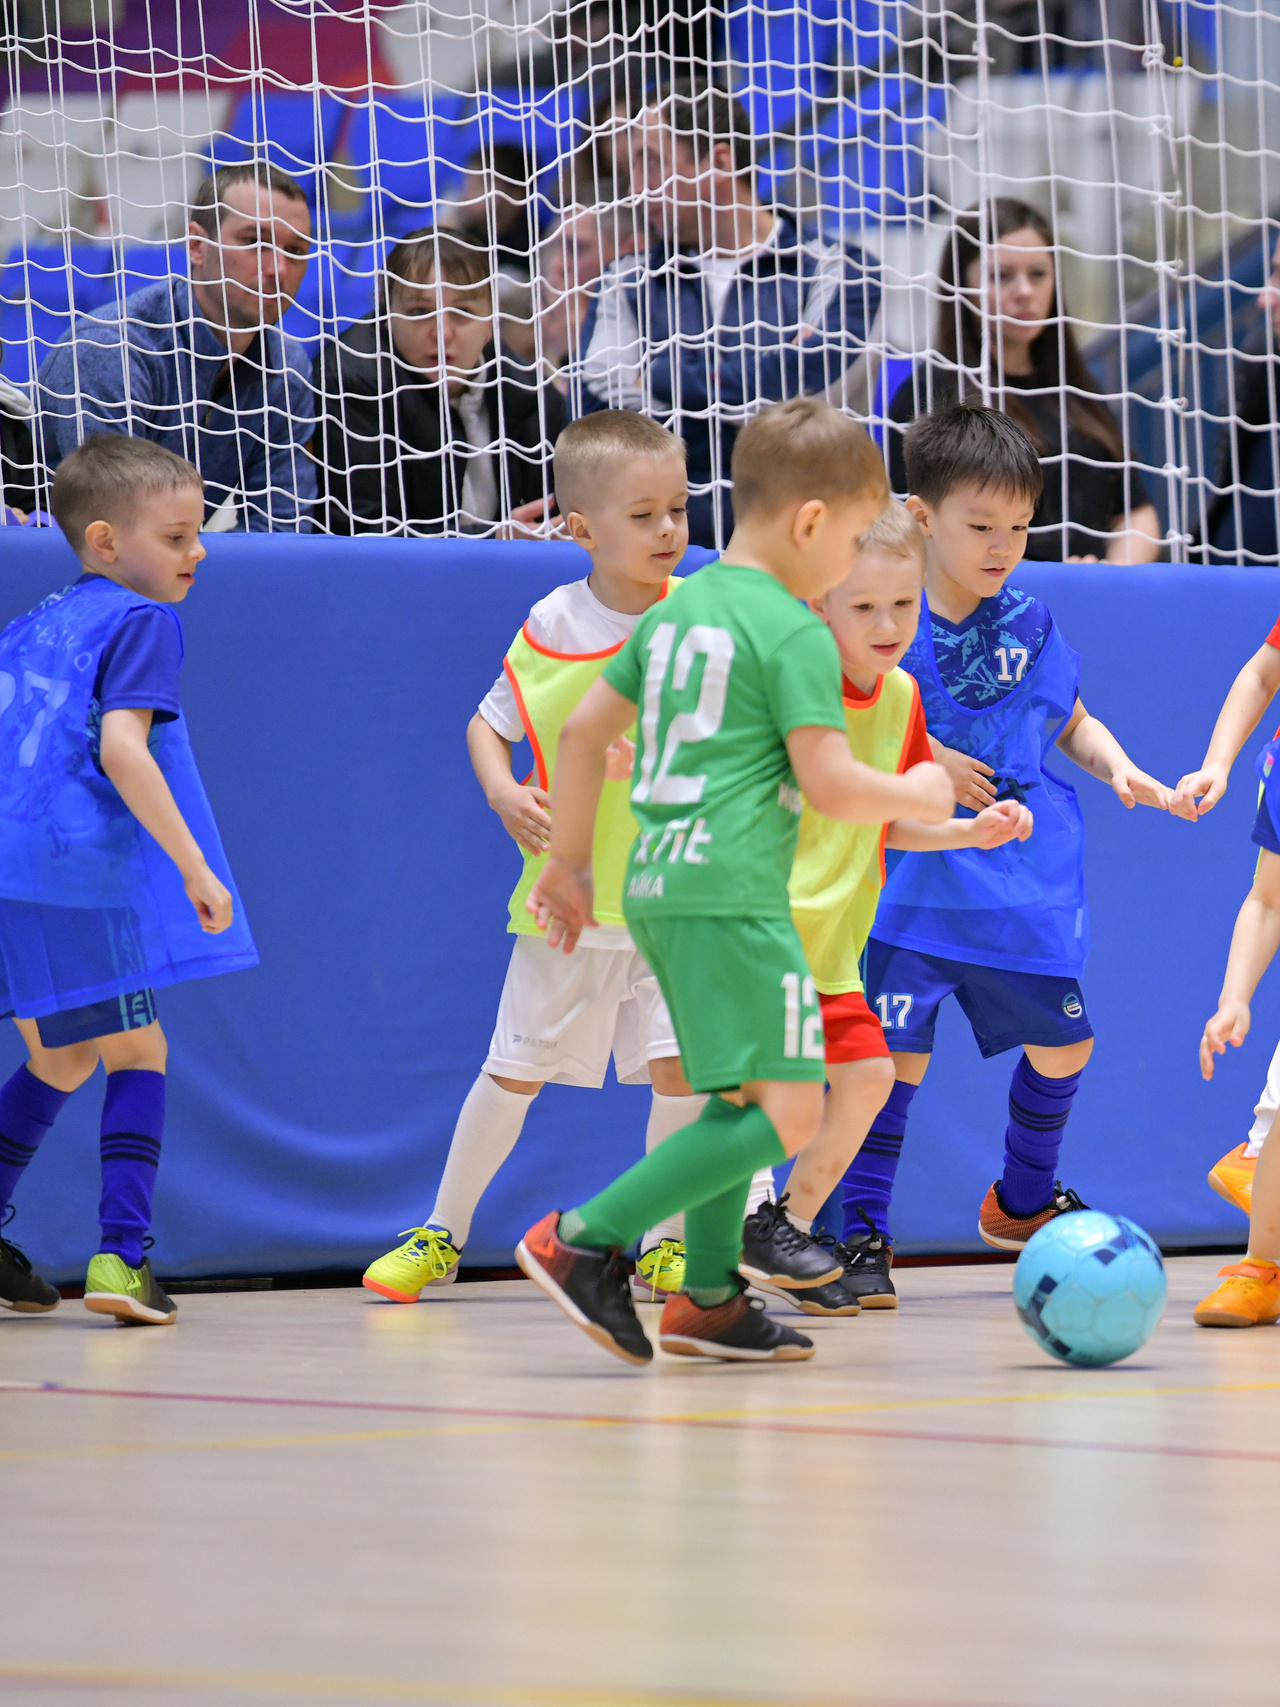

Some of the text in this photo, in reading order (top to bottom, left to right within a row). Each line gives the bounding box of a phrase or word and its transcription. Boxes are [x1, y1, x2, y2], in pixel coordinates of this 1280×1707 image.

[994, 647, 1028, 682] 17
[630, 622, 736, 804] 12
[780, 972, 825, 1060] 12
[874, 992, 914, 1029] 17
